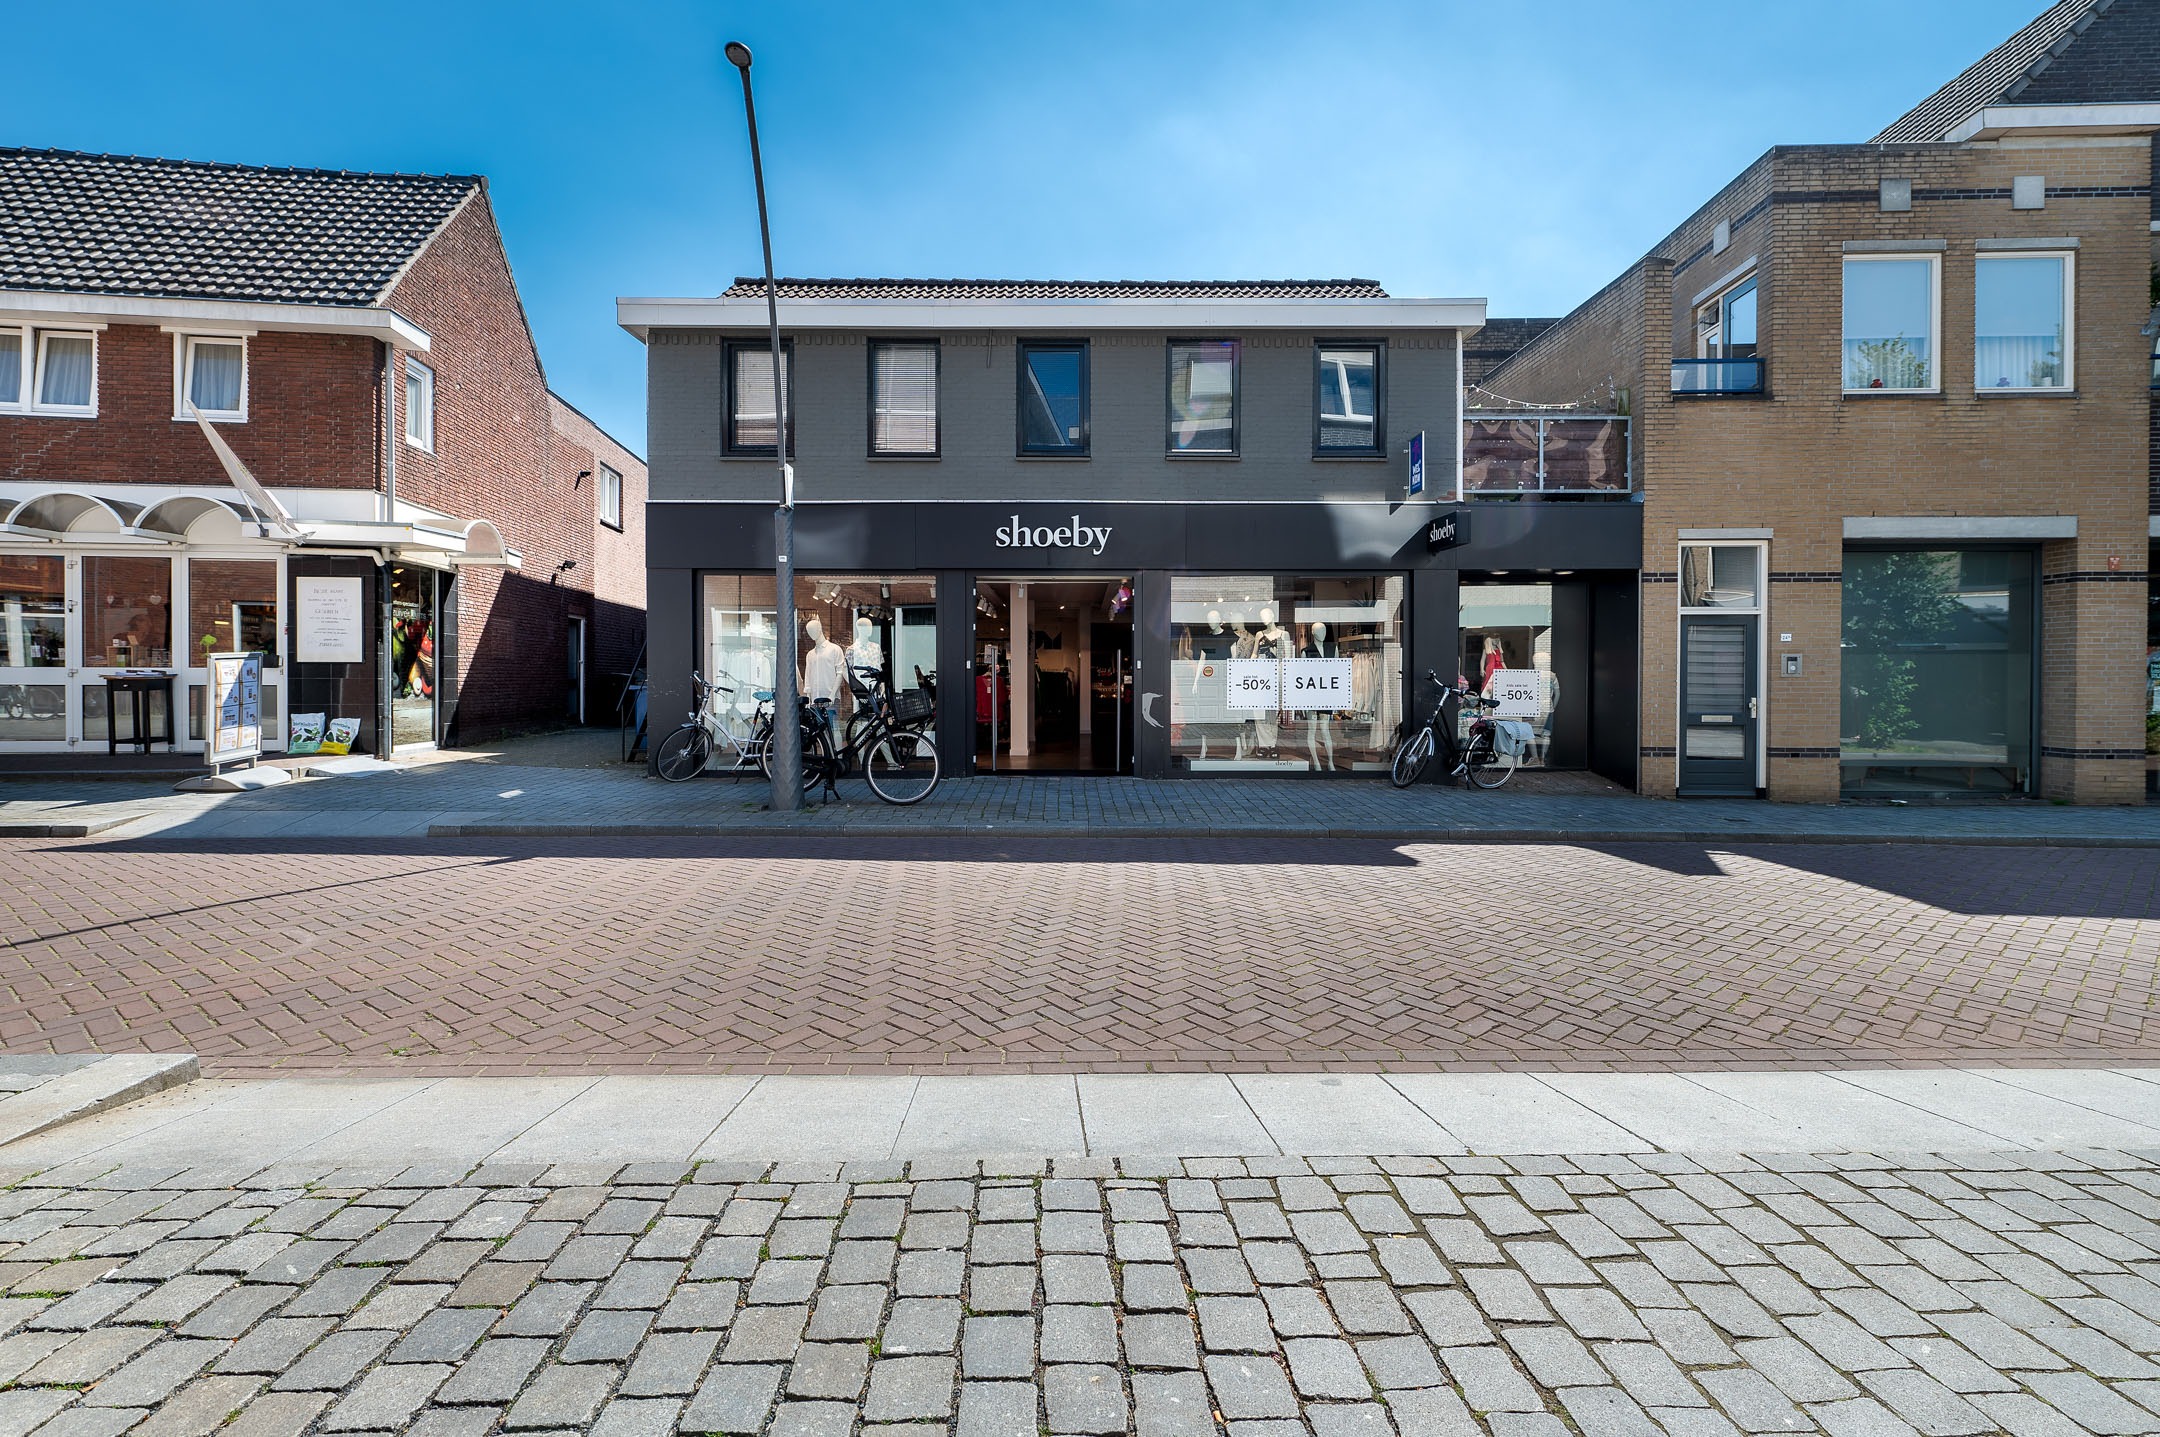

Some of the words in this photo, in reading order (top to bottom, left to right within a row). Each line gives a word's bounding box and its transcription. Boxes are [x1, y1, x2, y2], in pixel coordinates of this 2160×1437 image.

[995, 514, 1113, 556] shoeby
[1429, 519, 1456, 543] shoeby
[1235, 679, 1271, 691] -50%
[1295, 676, 1340, 690] SALE
[1500, 690, 1534, 701] -50%
